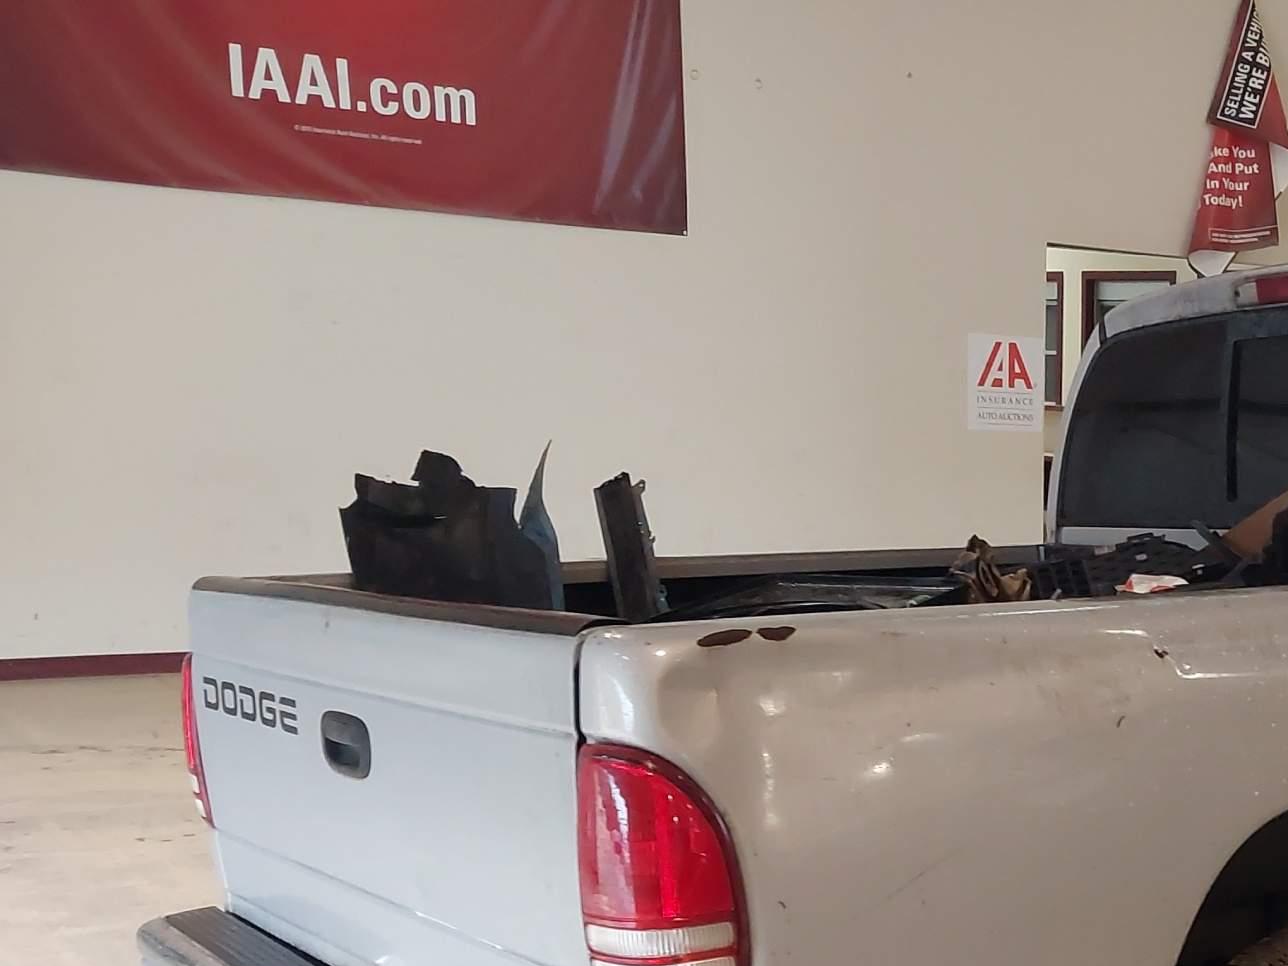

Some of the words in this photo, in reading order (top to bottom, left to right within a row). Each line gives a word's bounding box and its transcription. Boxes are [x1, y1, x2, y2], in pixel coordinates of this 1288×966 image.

[227, 42, 478, 127] IAAI.com
[1225, 64, 1251, 117] SELLING
[1241, 51, 1255, 62] A
[1238, 67, 1268, 119] WE'RE
[1209, 146, 1230, 158] ke
[1232, 145, 1256, 159] You
[1208, 162, 1233, 174] And
[1235, 162, 1260, 175] Put
[1206, 178, 1220, 190] In
[1222, 177, 1250, 191] Your
[1203, 193, 1243, 210] Today!
[977, 396, 1033, 406] INSURANCE
[978, 411, 997, 420] AUTO
[998, 412, 1034, 422] AUCTIONS
[202, 676, 299, 735] DODGE
